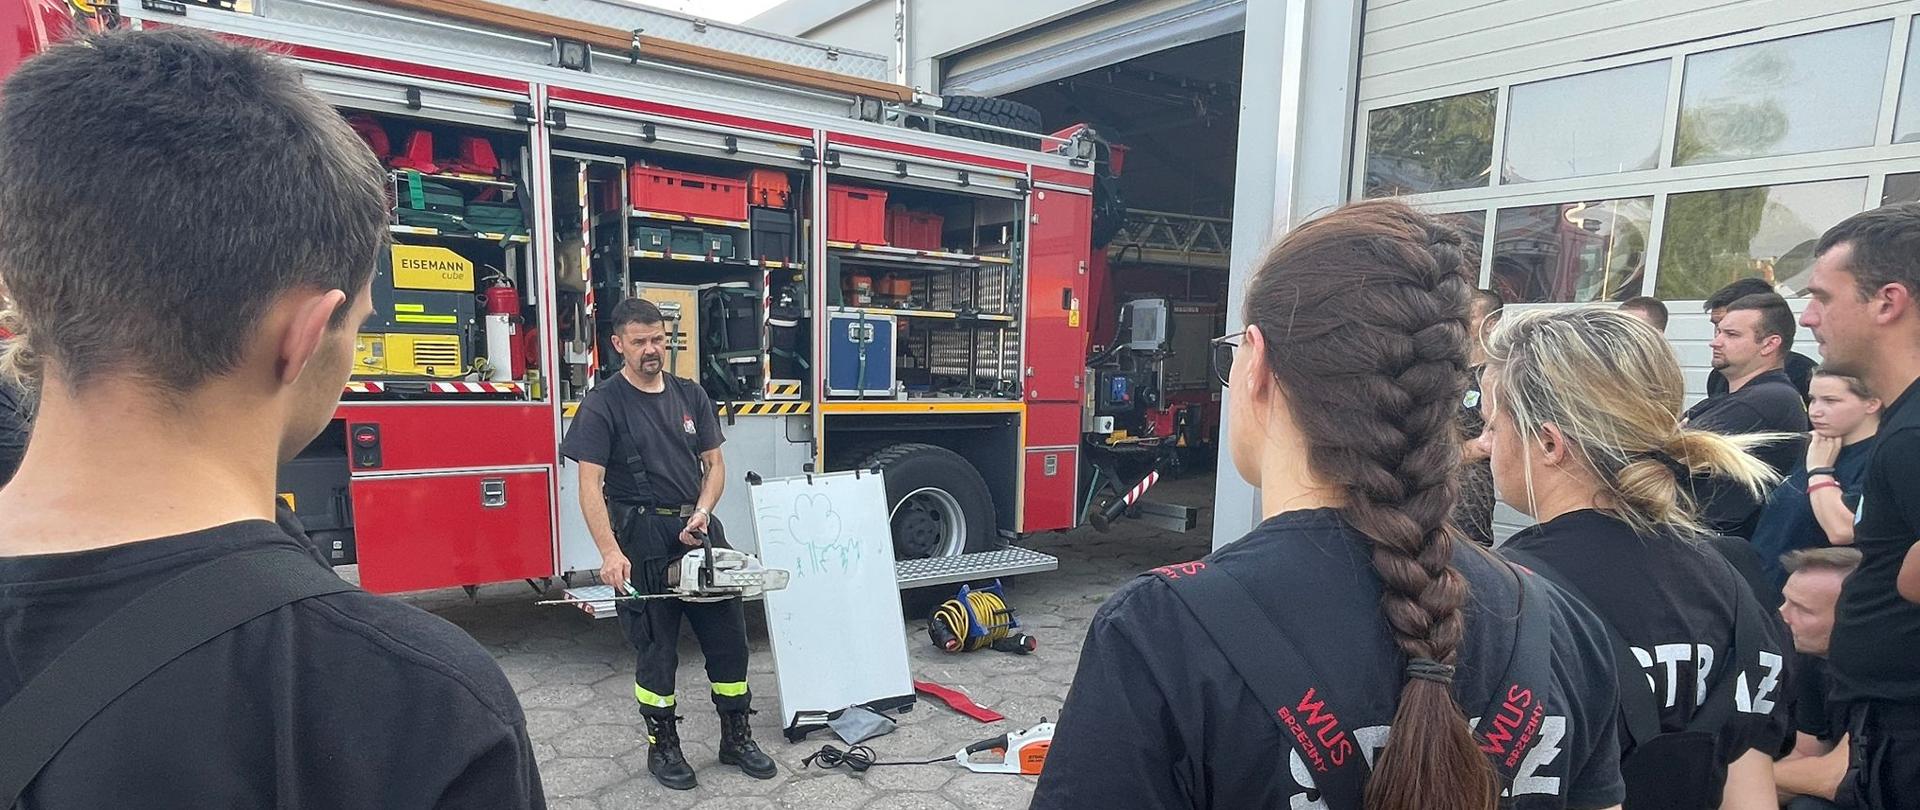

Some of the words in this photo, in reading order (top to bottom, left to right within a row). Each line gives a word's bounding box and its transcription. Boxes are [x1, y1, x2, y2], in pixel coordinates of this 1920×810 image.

[401, 258, 464, 271] EISEMANN
[442, 270, 464, 280] cube
[1277, 706, 1329, 772] BRZEZINY
[1296, 687, 1353, 767] WUS
[1480, 684, 1532, 754] WUS
[1505, 699, 1544, 768] BRZEZINY
